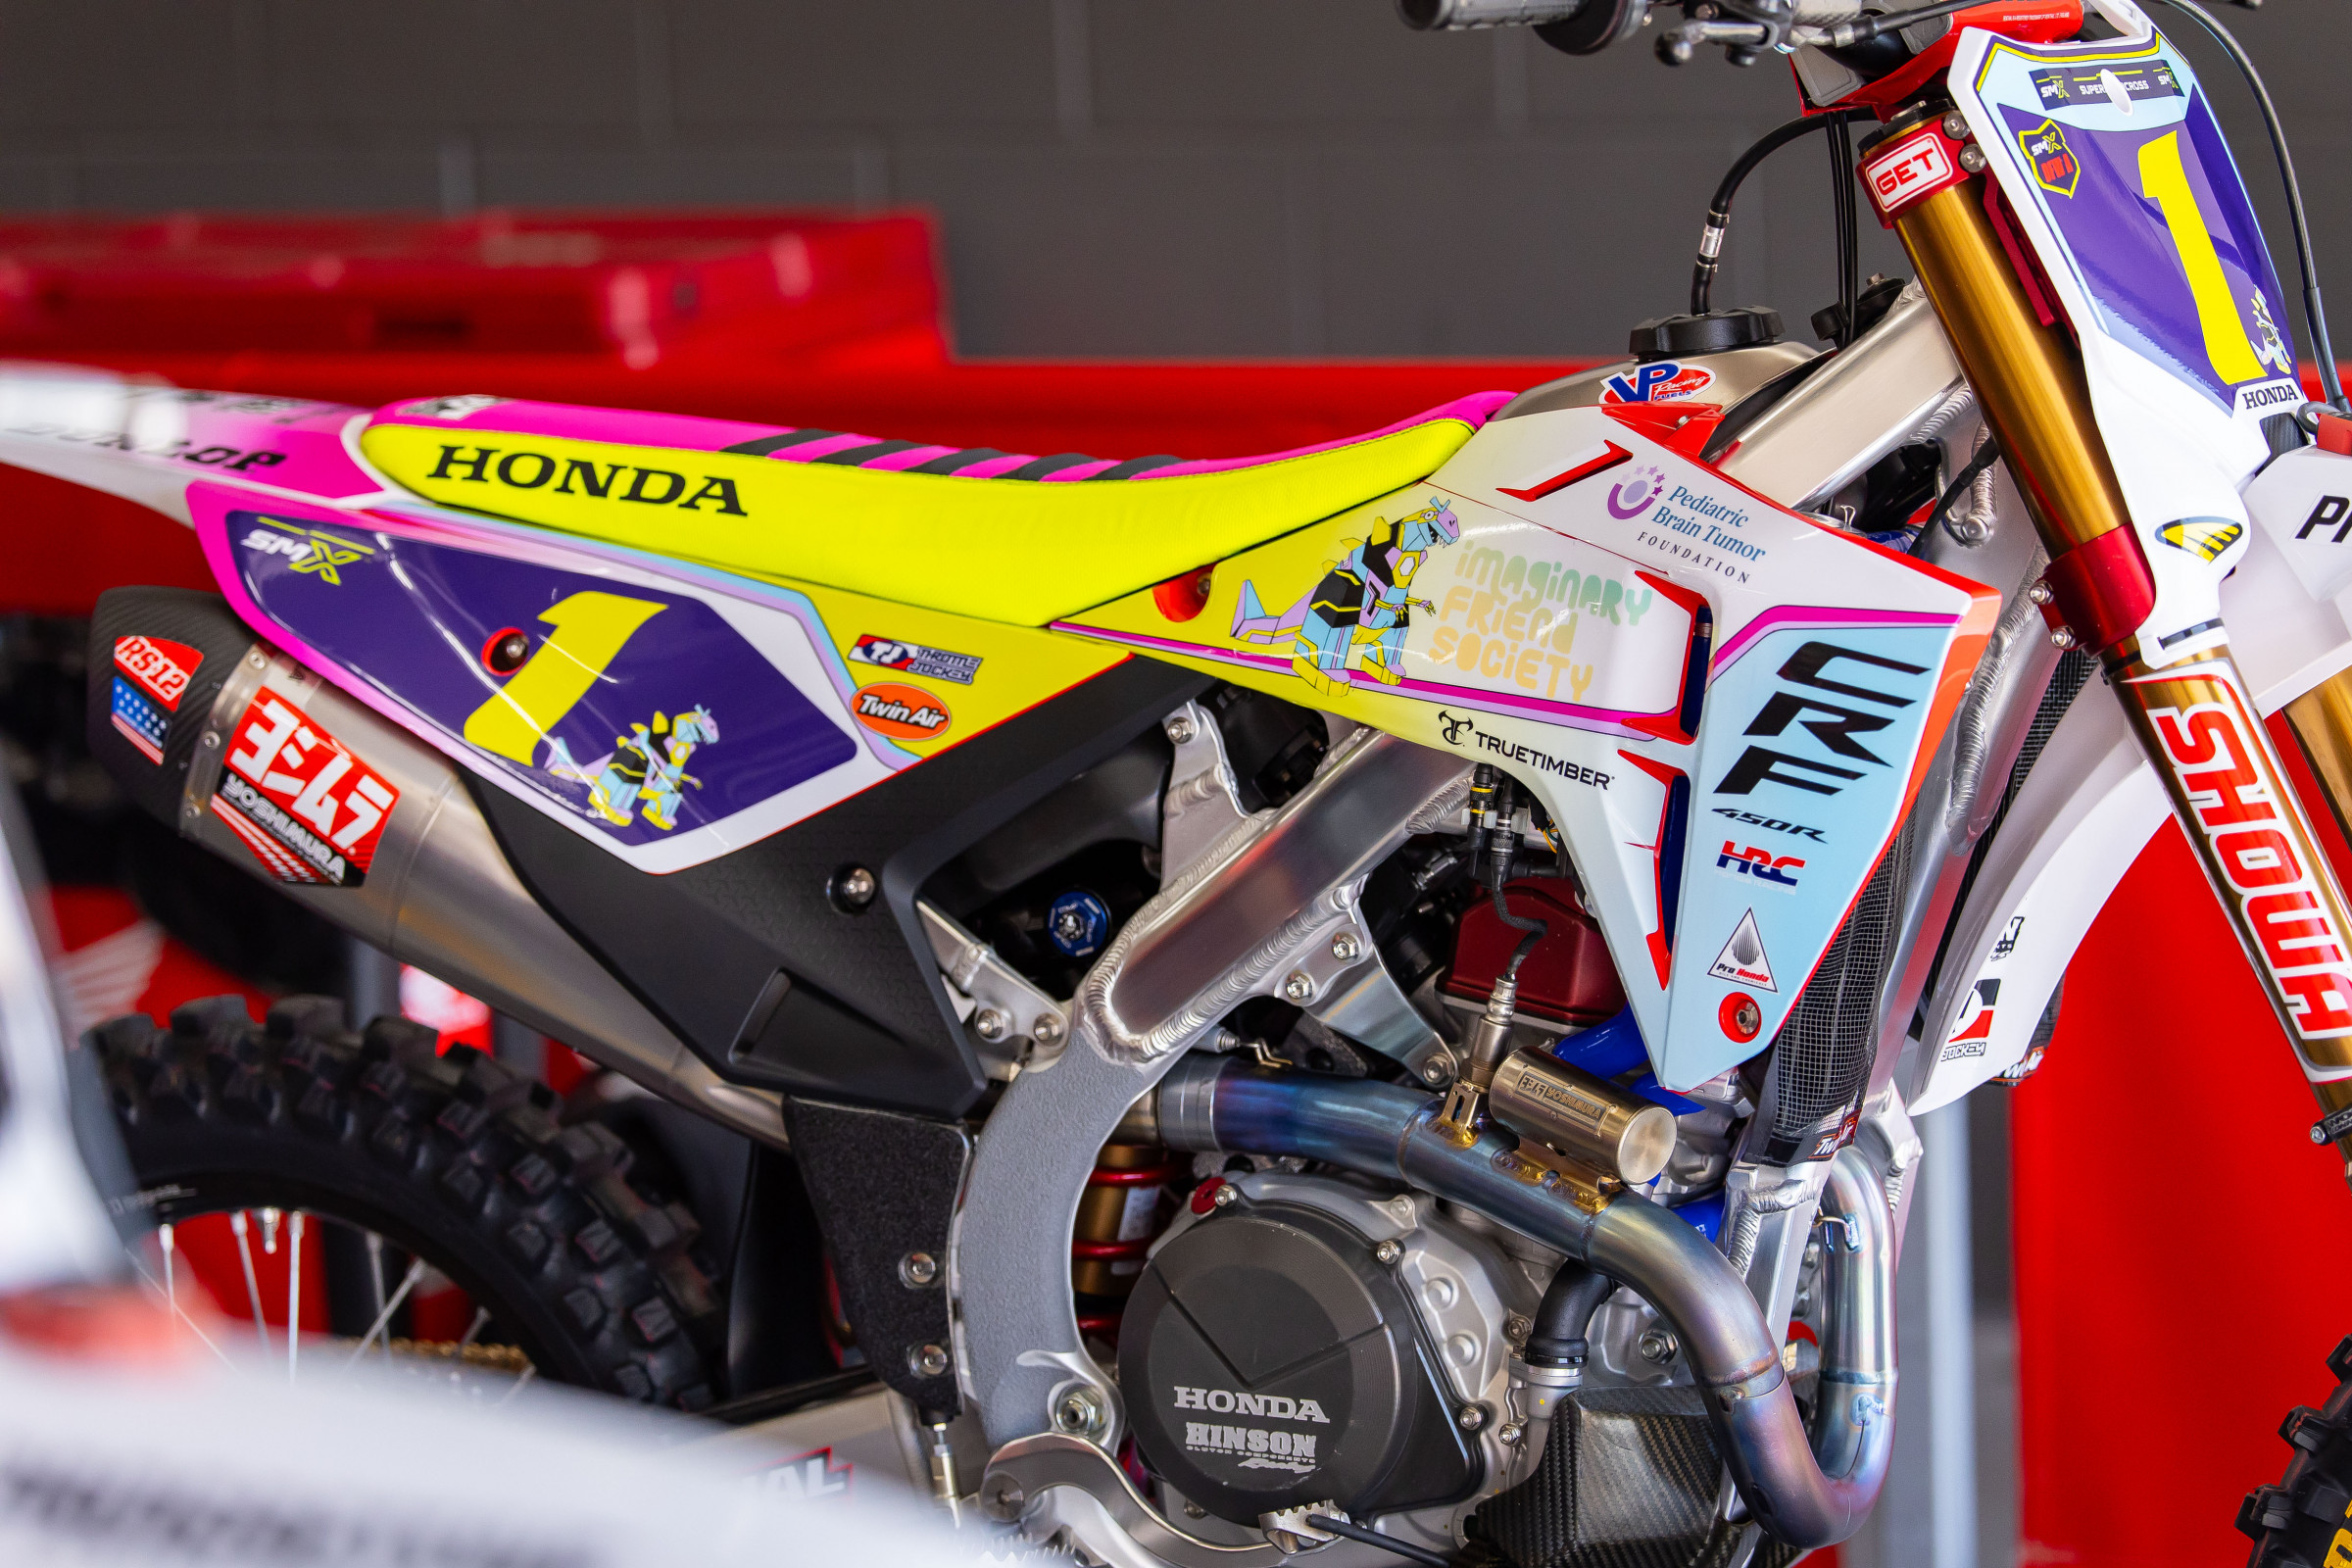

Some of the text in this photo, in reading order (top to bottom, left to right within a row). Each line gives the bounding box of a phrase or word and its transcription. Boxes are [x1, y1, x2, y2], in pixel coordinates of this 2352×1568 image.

[2040, 79, 2070, 99] SMX
[2031, 131, 2062, 156] SMX
[1876, 148, 1934, 195] GET
[2137, 130, 2268, 385] 1
[1608, 364, 1679, 402] VP
[1653, 389, 1692, 401] FUELS
[2242, 384, 2299, 410] HONDA
[425, 445, 749, 516] HONDA
[1667, 485, 1749, 528] Pediatric
[1651, 506, 1766, 562] Brain Tumor
[240, 529, 362, 586] SMX
[1638, 531, 1750, 584] FOUNDATION
[464, 590, 669, 767] 1
[910, 662, 970, 682] JOCKEY
[859, 694, 947, 729] Twin Air
[1713, 641, 1932, 796] CRF
[230, 699, 394, 851] ヨシムラ
[1476, 731, 1610, 790] TRUETIMBER
[222, 772, 345, 879] YOSHIMURA
[1711, 808, 1829, 845] 450R
[1716, 840, 1806, 887] HRC
[2152, 706, 2352, 1036] SHOWA
[1716, 963, 1769, 983] Pro Honda
[1941, 1042, 1986, 1061] JOCKEY
[1545, 1087, 1601, 1119] YOSHIMURA
[1173, 1386, 1330, 1423] HONDA
[1185, 1422, 1317, 1457] HINSON
[1237, 1450, 1316, 1464] COMPONENTS
